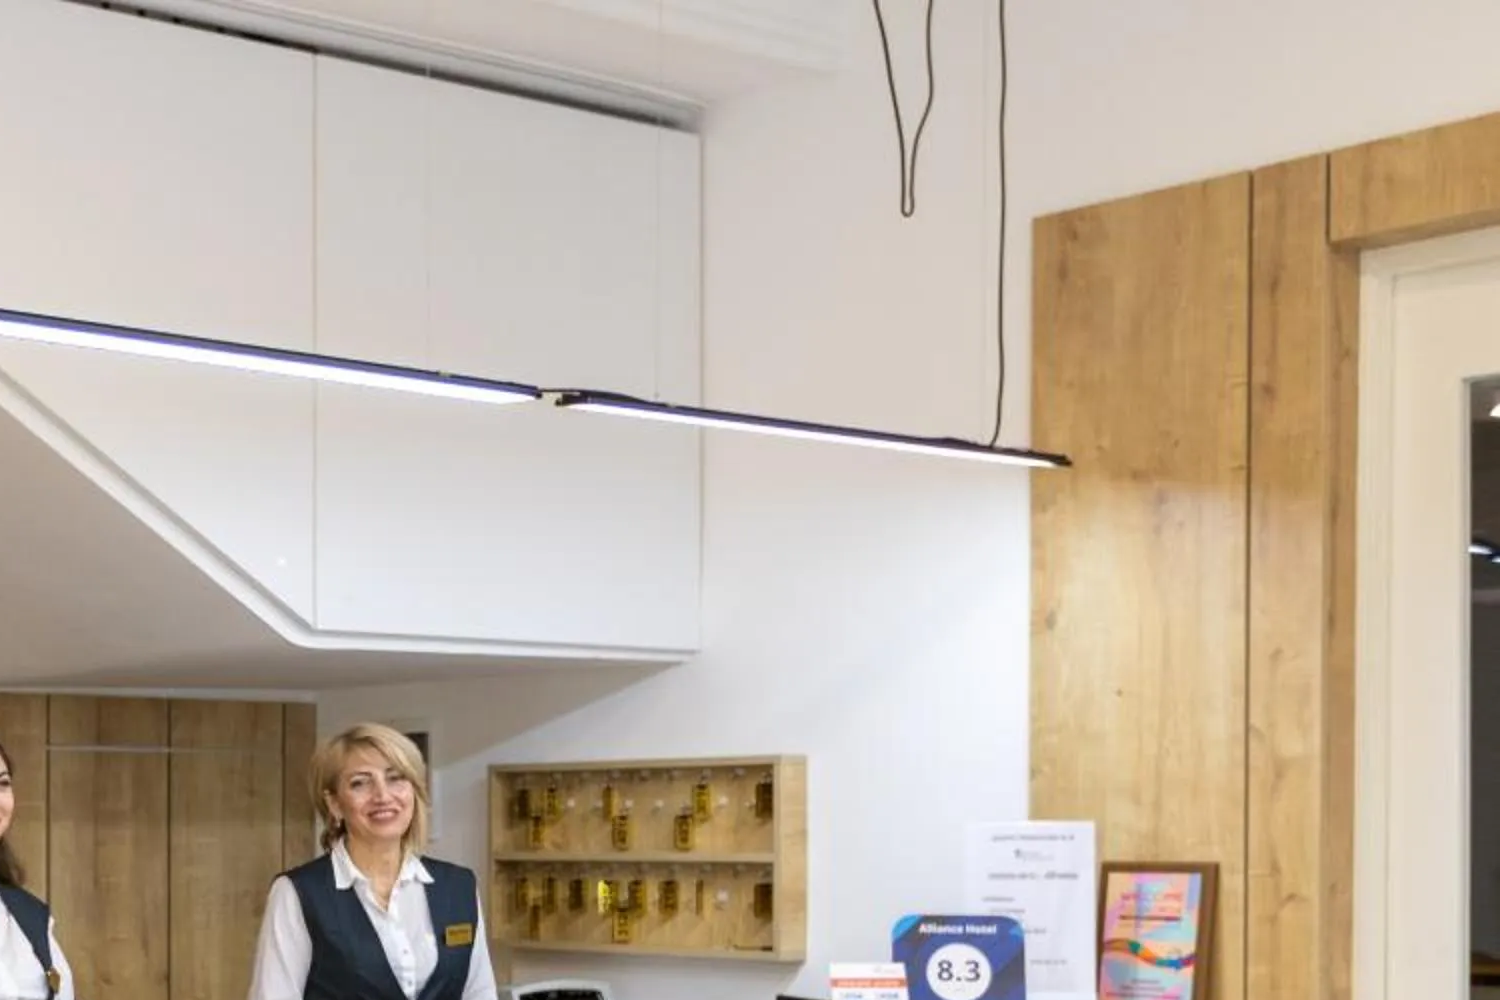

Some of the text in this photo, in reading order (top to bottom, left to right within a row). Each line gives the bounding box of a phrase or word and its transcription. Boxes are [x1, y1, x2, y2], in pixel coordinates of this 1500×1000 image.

[918, 922, 998, 934] Alliance Hotel
[937, 959, 981, 982] 8.3
